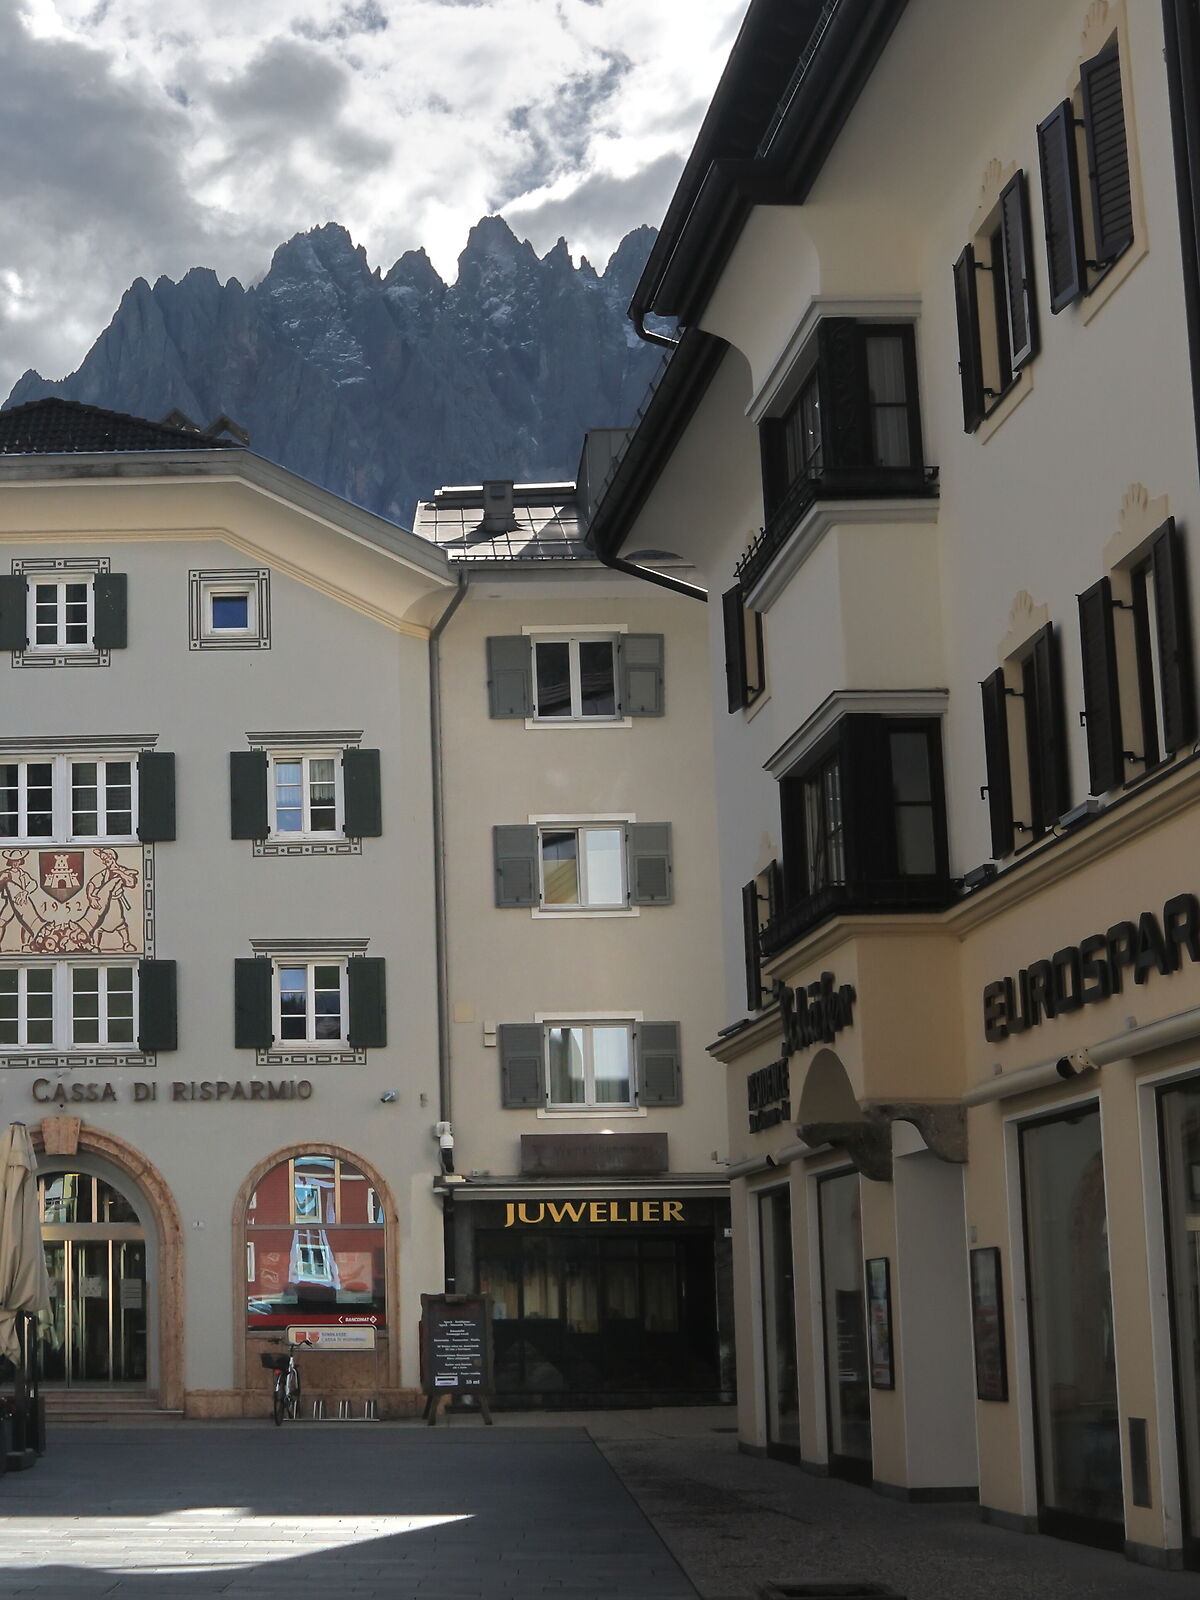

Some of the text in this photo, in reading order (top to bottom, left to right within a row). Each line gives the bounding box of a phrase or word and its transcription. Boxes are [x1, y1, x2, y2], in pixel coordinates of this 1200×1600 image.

[41, 902, 82, 914] 1952
[983, 893, 1200, 1043] EUROSPAR
[31, 1078, 312, 1103] CASSA DI RISPARMIO
[504, 1201, 685, 1228] JUWELIER
